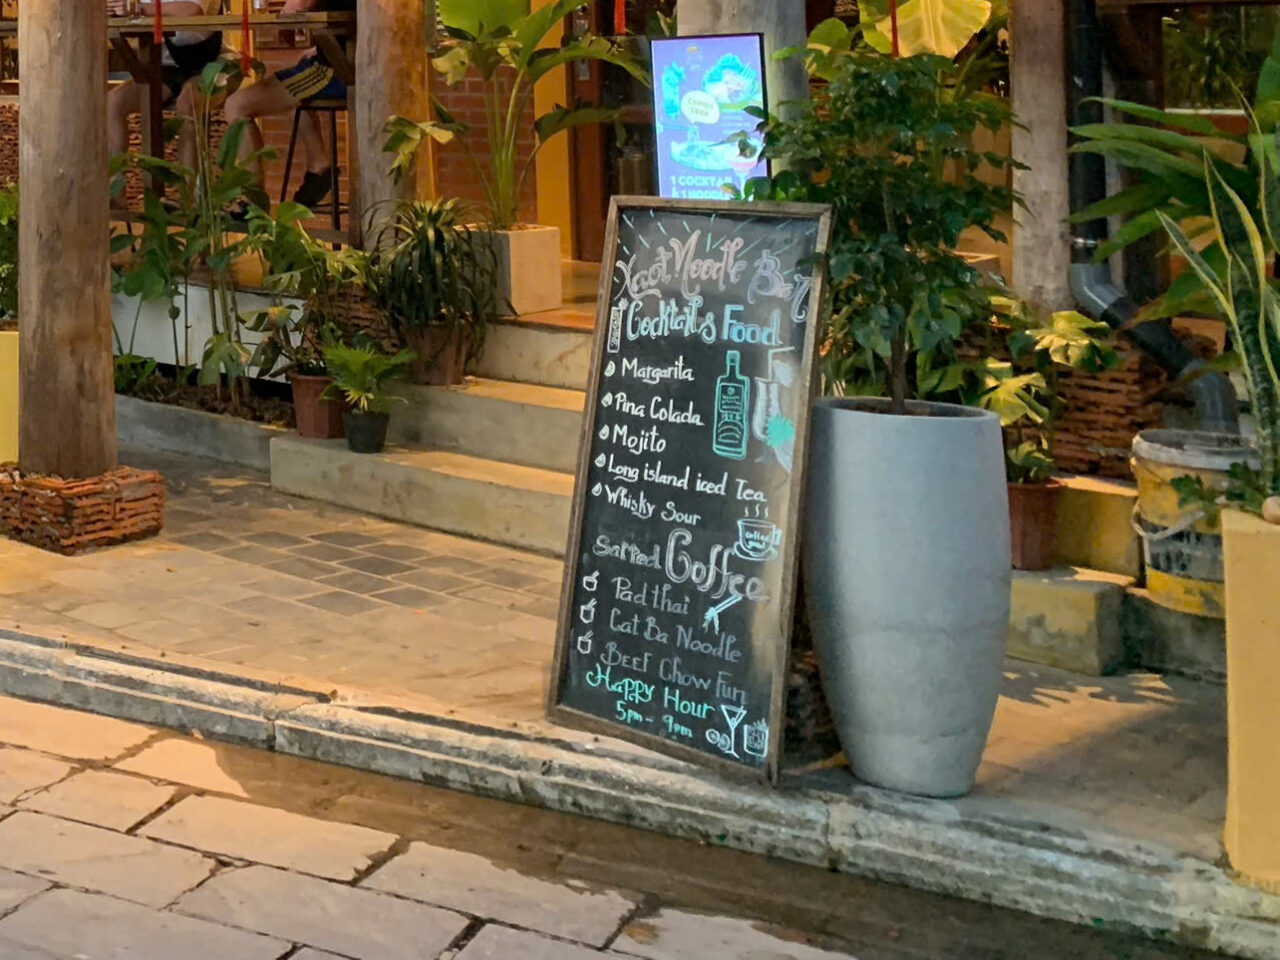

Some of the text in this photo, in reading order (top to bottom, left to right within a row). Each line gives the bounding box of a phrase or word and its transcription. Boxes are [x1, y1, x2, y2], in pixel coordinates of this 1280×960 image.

[669, 229, 749, 300] Noodle
[722, 304, 785, 346] Food
[621, 355, 695, 385] Margarita
[614, 392, 646, 417] Pina
[650, 396, 705, 427] Colada
[612, 424, 667, 455] Mojito
[608, 453, 767, 503] Long island iced Tea
[604, 484, 702, 525] Whisky Sour
[665, 527, 771, 602] Coffee
[610, 607, 742, 663] Cat Ba Noodle
[659, 656, 712, 690] Chow
[715, 671, 748, 705] Fun
[616, 700, 644, 724] 5pm
[662, 714, 694, 739] 9pm
[664, 686, 715, 719] Hour
